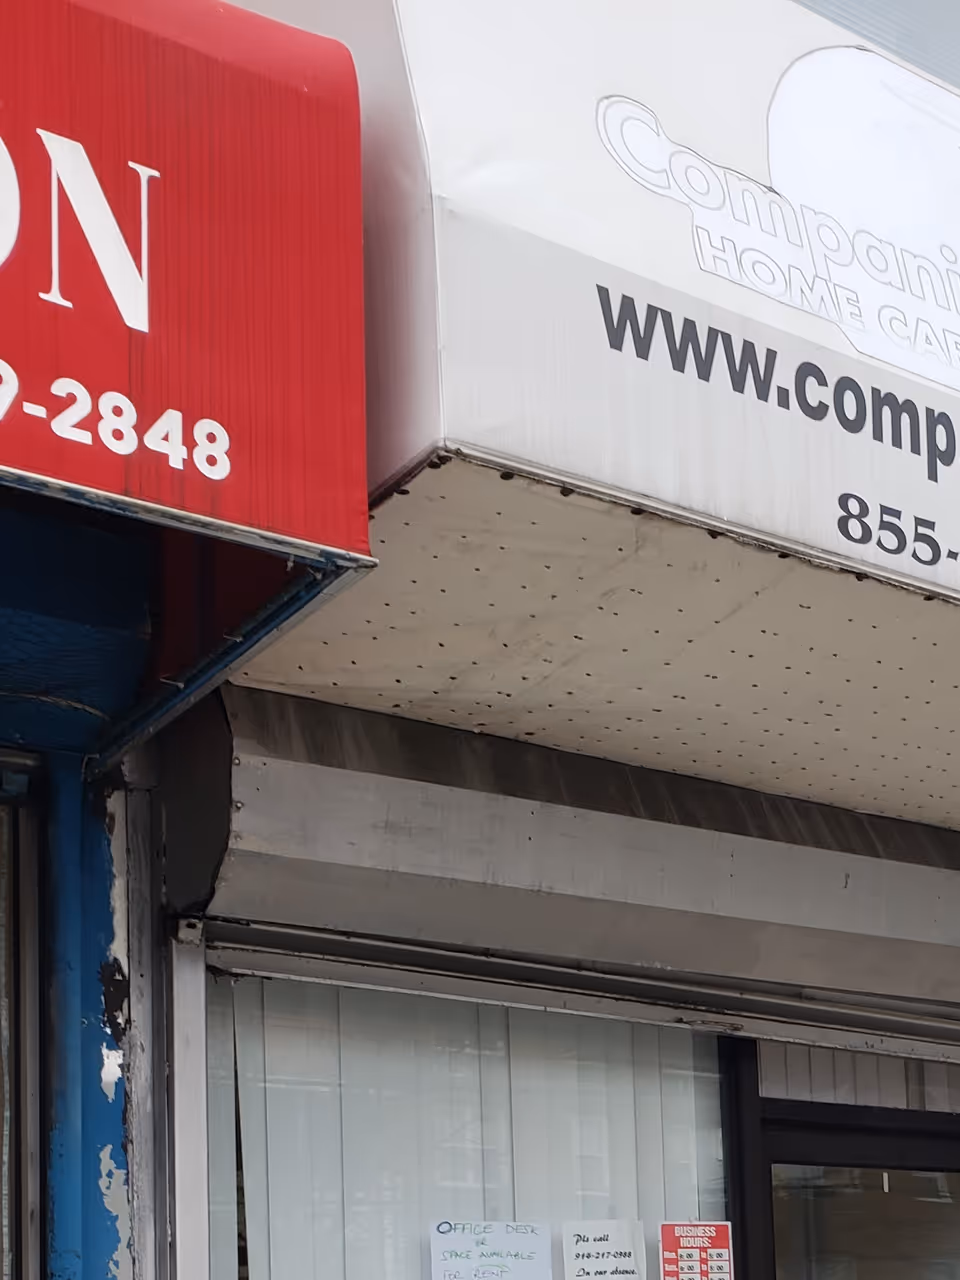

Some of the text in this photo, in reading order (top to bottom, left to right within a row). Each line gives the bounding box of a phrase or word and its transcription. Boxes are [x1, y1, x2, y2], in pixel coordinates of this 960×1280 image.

[696, 224, 864, 328] HOME
[436, 1221, 494, 1235] OFFICE
[674, 1226, 717, 1237] BUSINESS
[593, 1233, 609, 1242] call
